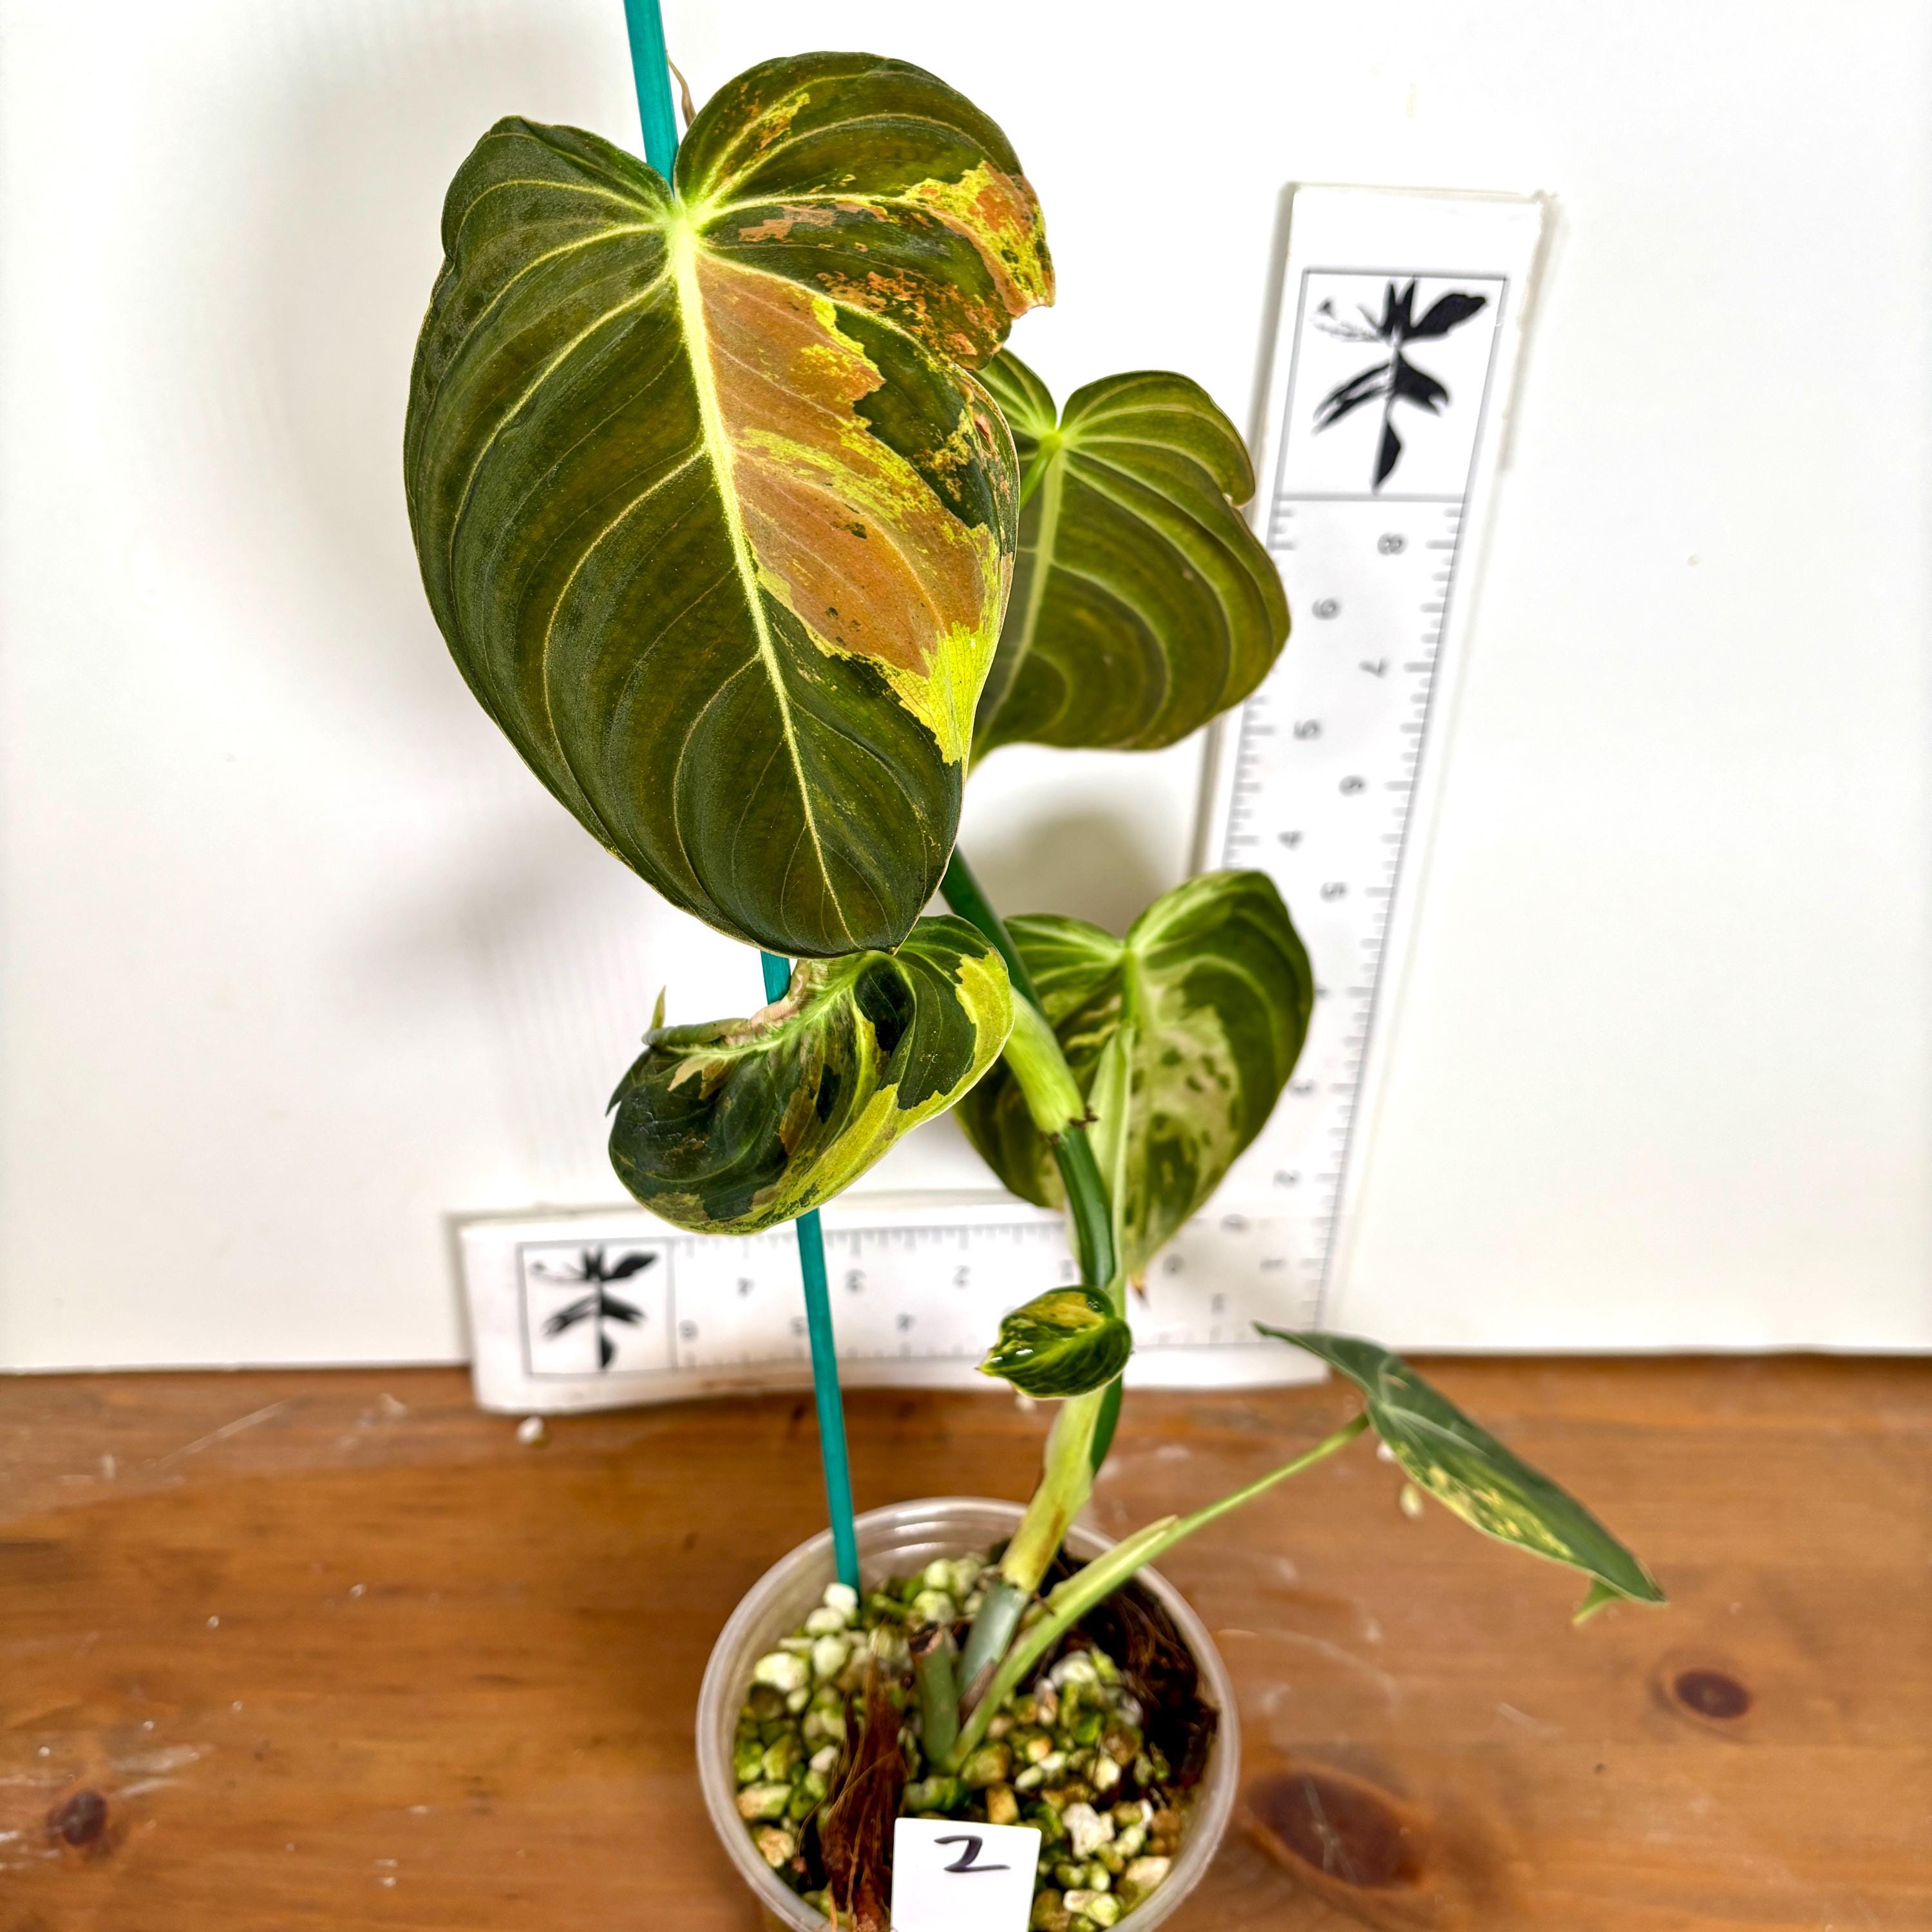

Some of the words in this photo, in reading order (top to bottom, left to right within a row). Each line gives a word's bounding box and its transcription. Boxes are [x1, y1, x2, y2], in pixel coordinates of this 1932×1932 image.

[1377, 533, 1407, 555] 8
[1358, 658, 1389, 678] 7
[934, 1835, 1011, 1873] 2
